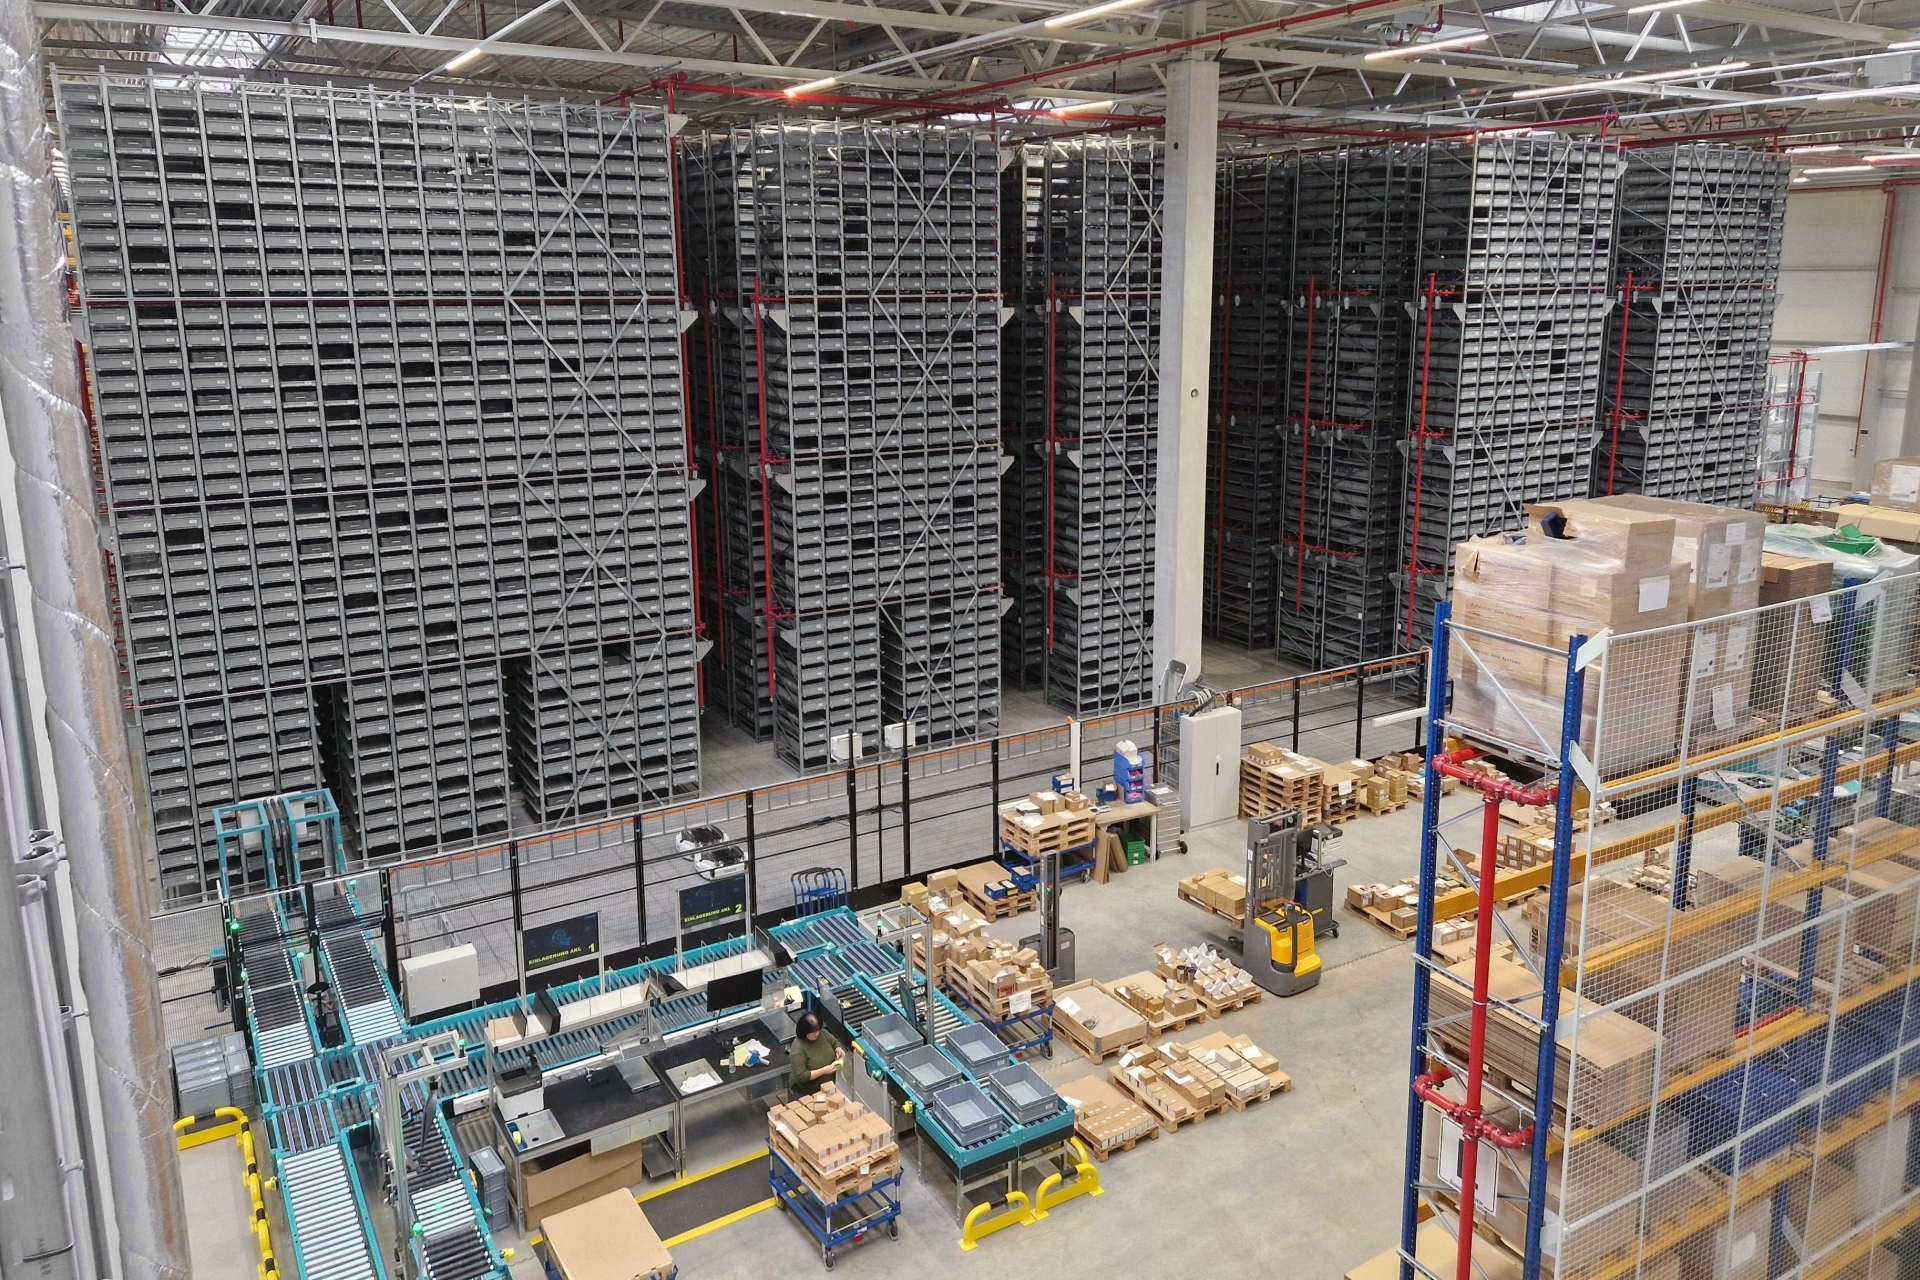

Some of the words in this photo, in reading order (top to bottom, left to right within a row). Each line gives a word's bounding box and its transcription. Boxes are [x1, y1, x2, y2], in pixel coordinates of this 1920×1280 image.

[684, 908, 720, 923] EINLAGERUNG
[734, 903, 743, 914] 2
[528, 950, 569, 965] EINLAGERUNG
[588, 942, 595, 953] 1
